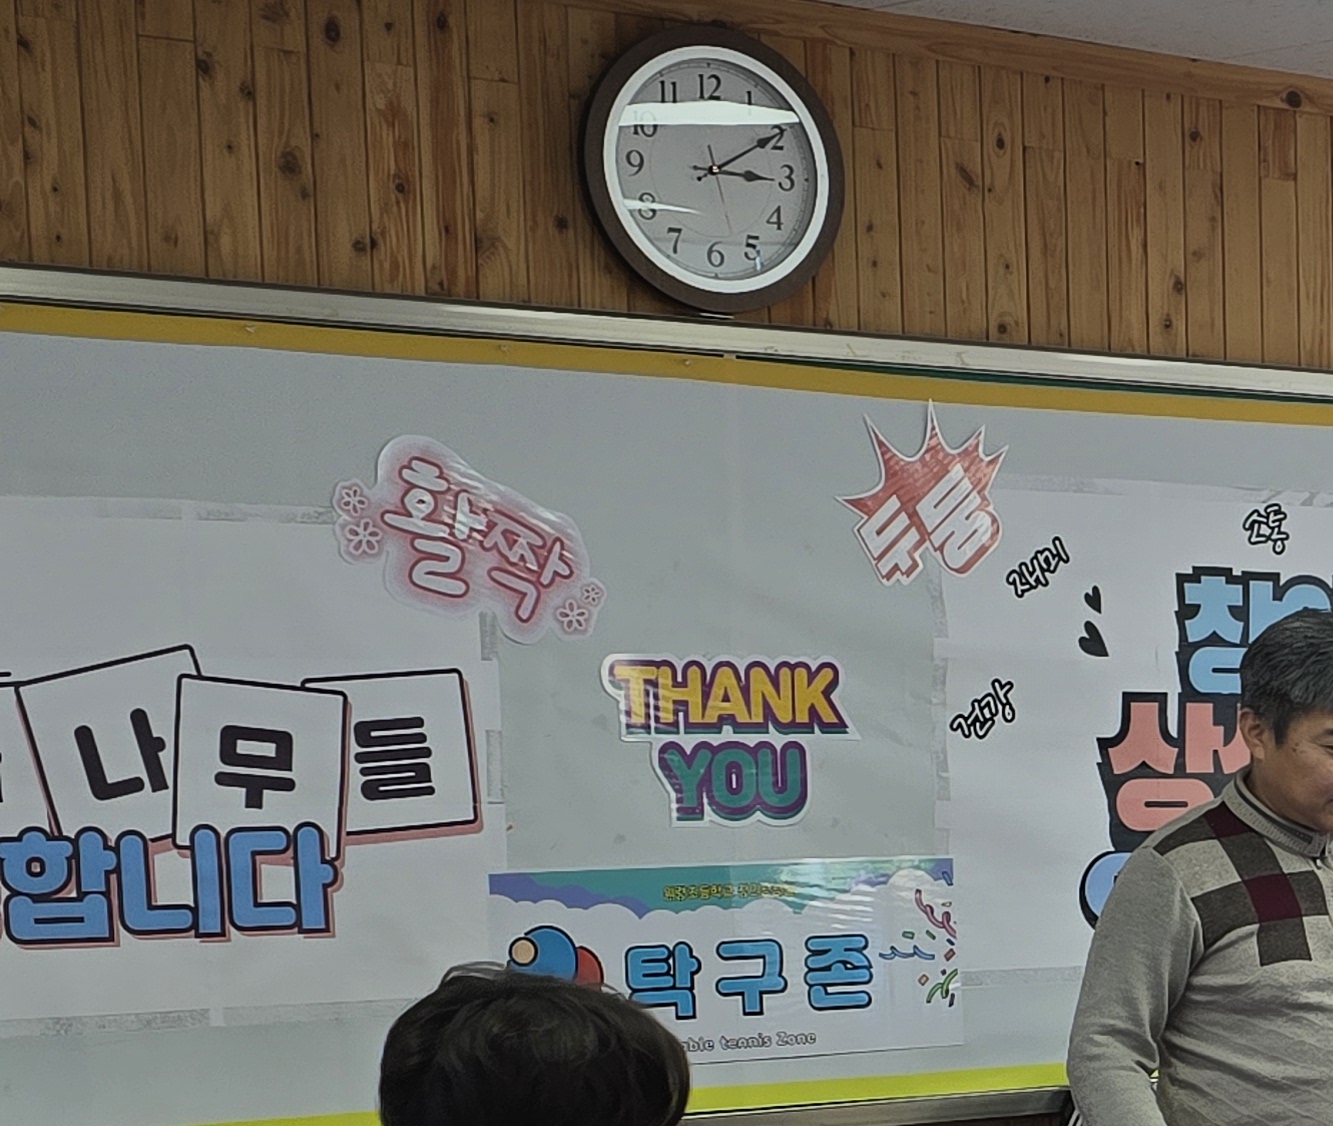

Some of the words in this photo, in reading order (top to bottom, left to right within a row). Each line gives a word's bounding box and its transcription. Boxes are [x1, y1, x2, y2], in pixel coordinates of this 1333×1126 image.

[660, 80, 677, 103] 11
[698, 74, 721, 100] 12
[770, 125, 786, 150] 2
[625, 150, 644, 176] 9
[778, 164, 795, 191] 3
[638, 193, 657, 220] 8
[766, 205, 783, 230] 4
[667, 227, 683, 254] 7
[707, 241, 724, 267] 6
[744, 235, 761, 261] 5
[381, 456, 574, 622] 활짝
[1243, 503, 1289, 555] 소통
[1006, 537, 1069, 598] 재미
[610, 661, 846, 730] THANK
[950, 678, 1015, 739] 건강
[660, 743, 805, 816] YOU
[0, 822, 338, 942] 합니다
[625, 934, 873, 1020] 탁구존
[682, 1037, 715, 1053] able
[720, 1033, 772, 1051] tennis
[776, 1031, 817, 1048] Zone
